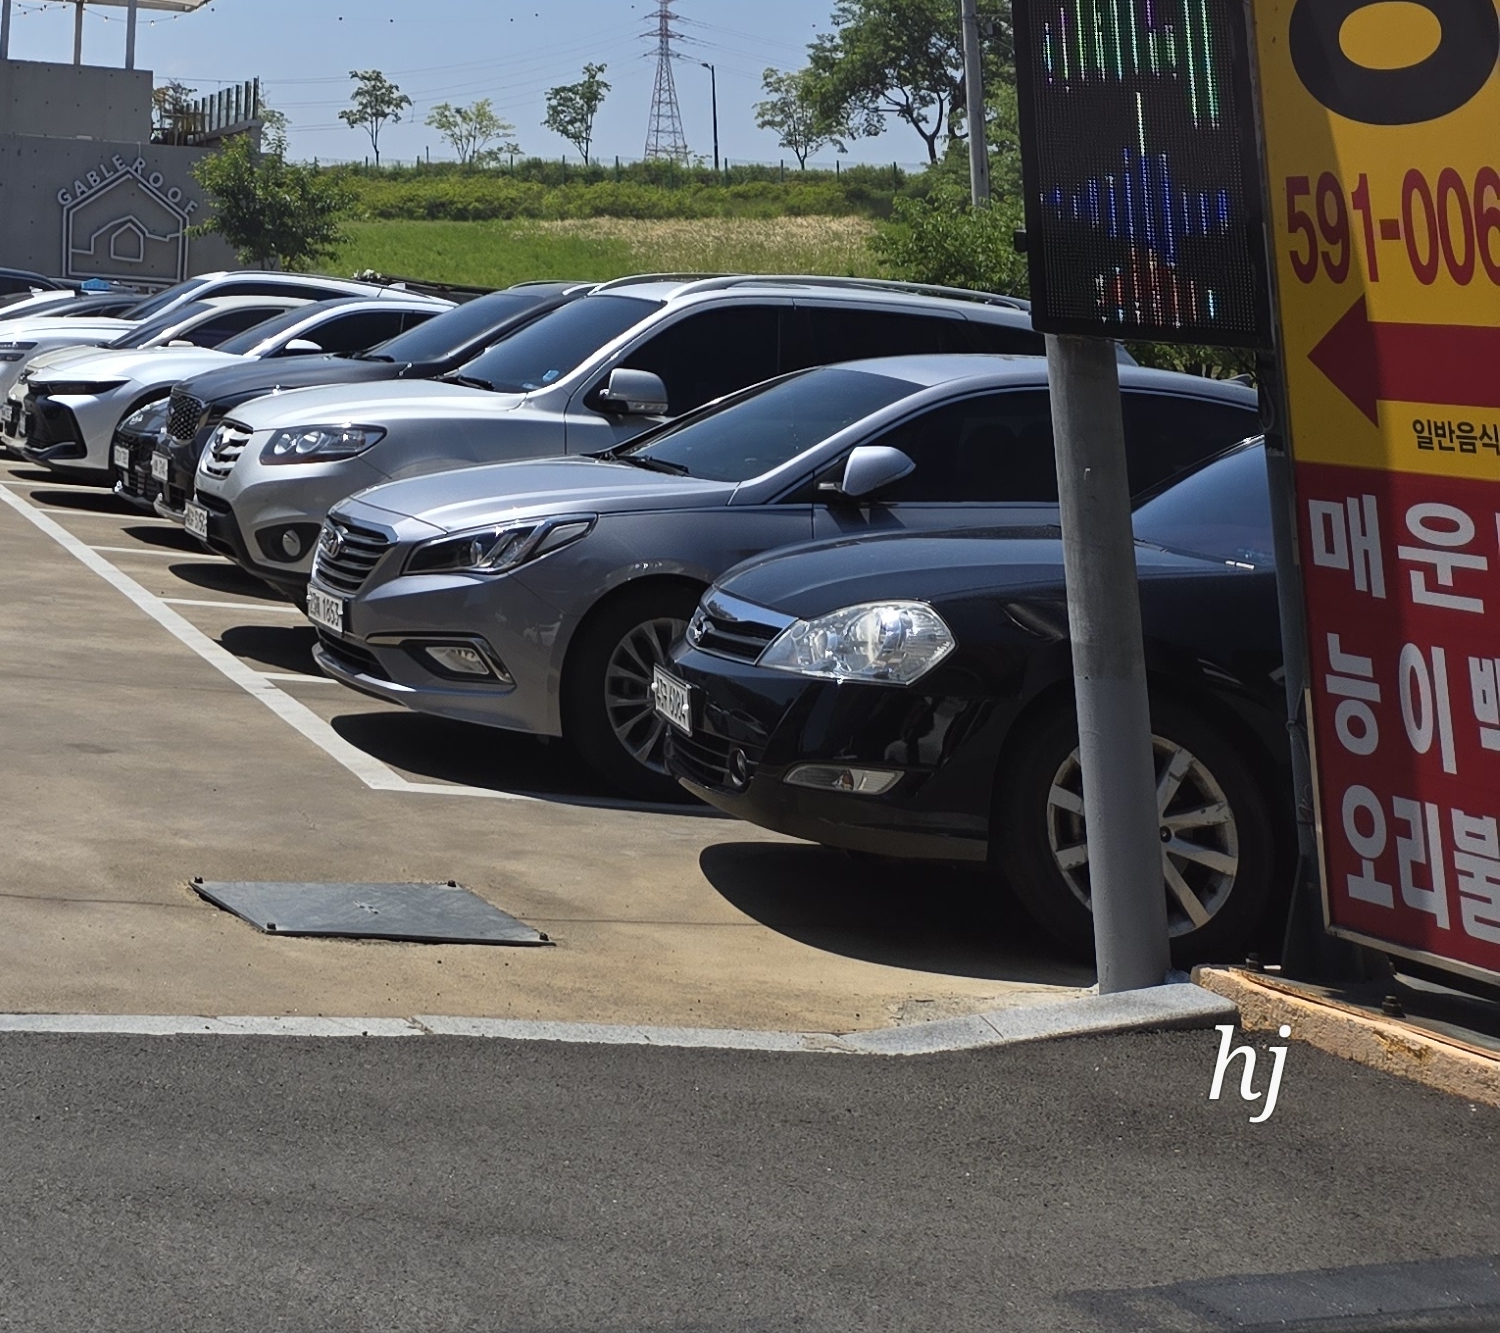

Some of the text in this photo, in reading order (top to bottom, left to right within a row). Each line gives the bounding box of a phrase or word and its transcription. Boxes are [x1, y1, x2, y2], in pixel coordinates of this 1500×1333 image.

[57, 154, 198, 214] GABLE ROOF
[1412, 419, 1500, 456] 일반음식
[1308, 494, 1500, 614] 매운
